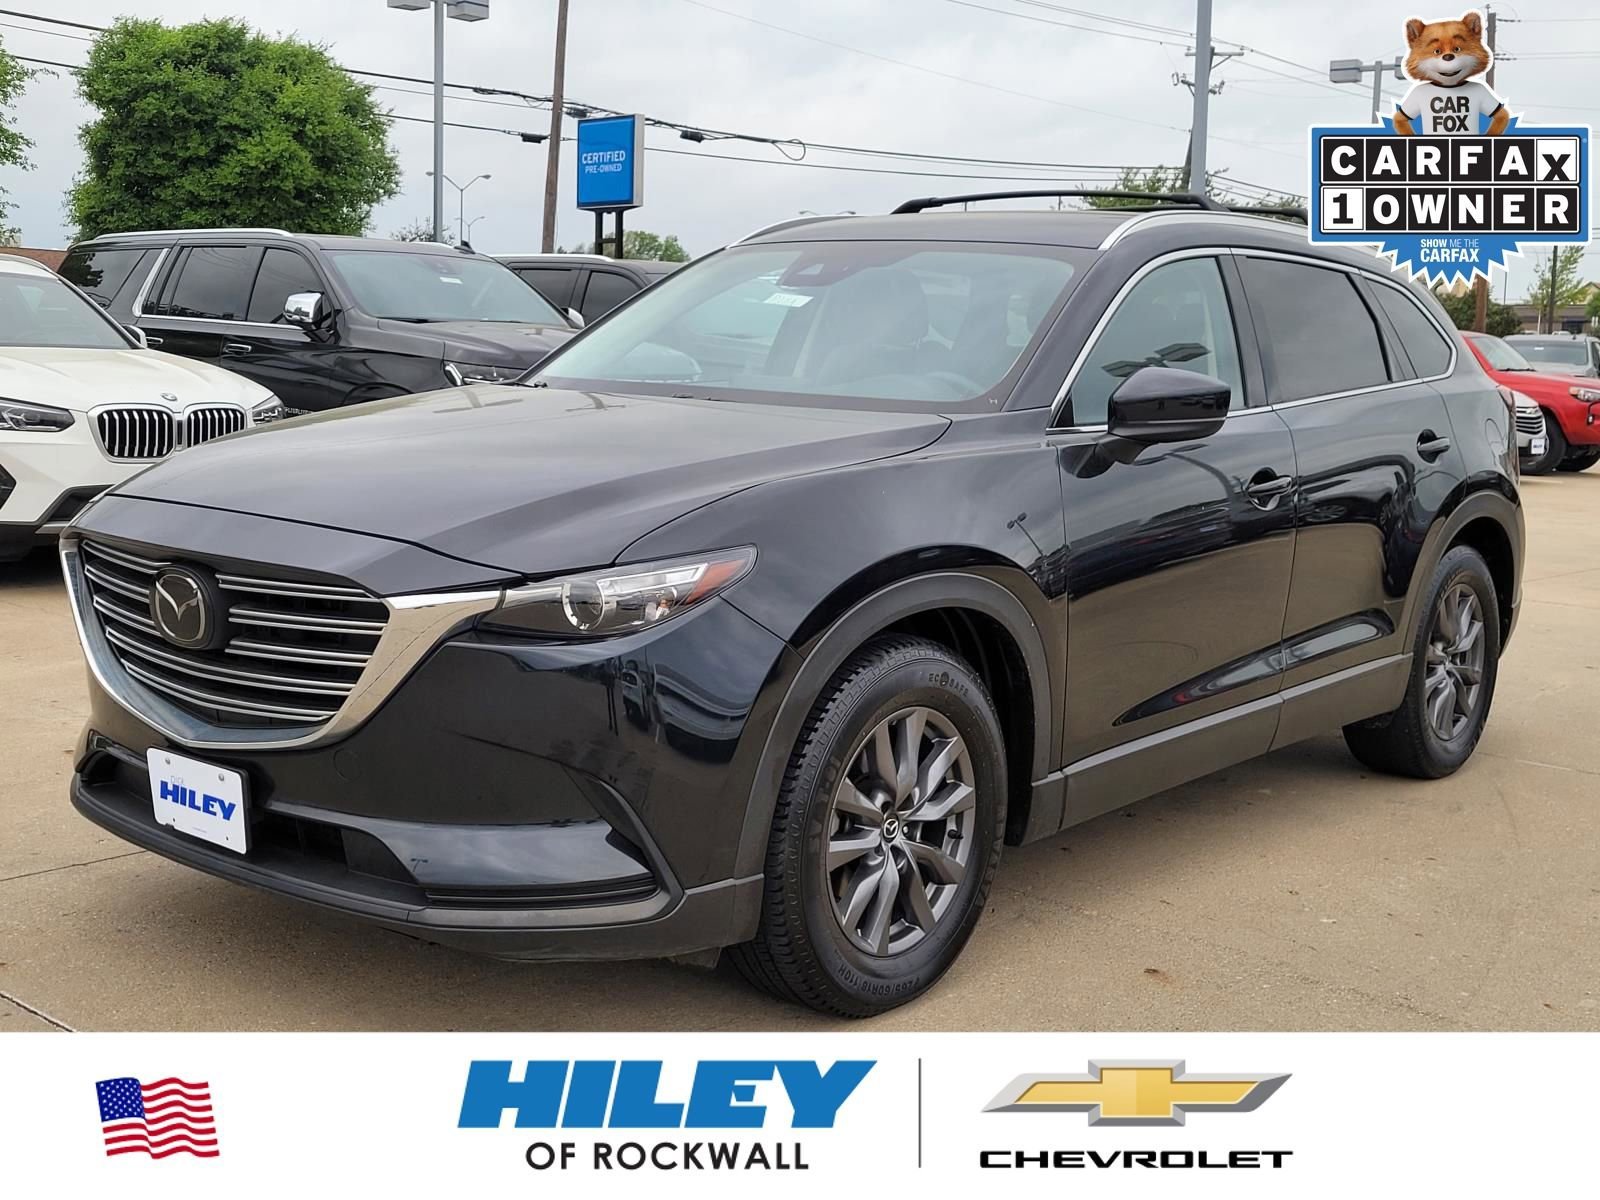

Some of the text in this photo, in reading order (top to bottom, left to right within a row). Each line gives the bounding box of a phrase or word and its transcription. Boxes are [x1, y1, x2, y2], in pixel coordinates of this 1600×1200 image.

[582, 150, 626, 164] CERTIFIED
[584, 163, 623, 173] PRE-OWNED
[160, 780, 237, 821] HILEY
